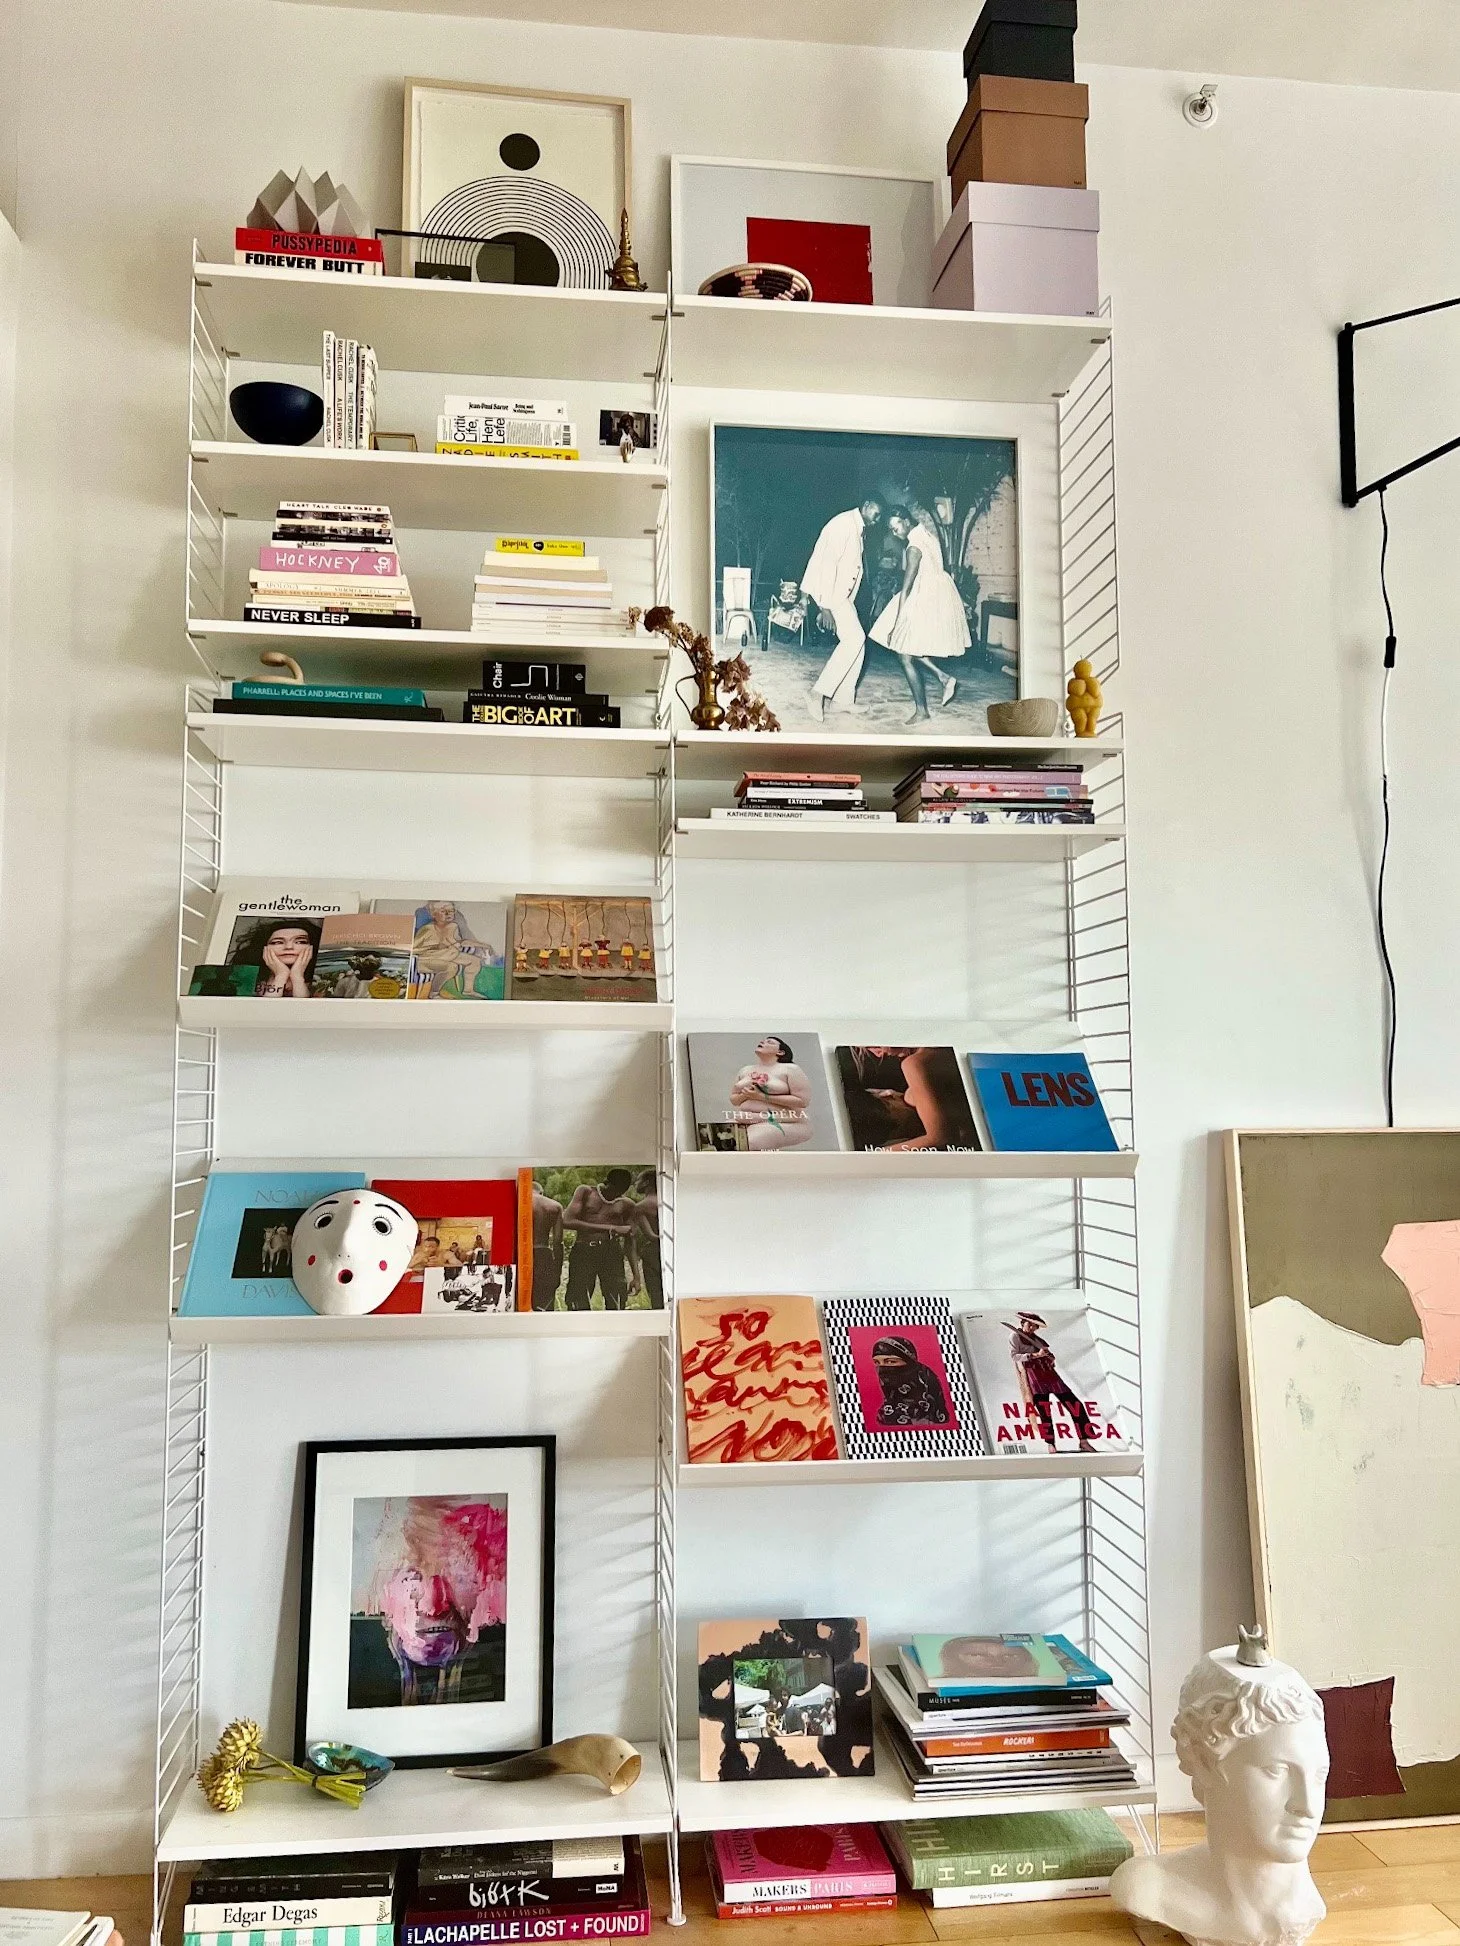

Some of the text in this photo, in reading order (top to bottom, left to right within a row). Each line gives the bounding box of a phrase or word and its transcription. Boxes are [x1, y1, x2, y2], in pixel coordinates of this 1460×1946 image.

[272, 234, 357, 254] PUSSYPEDIA
[245, 253, 364, 274] FOREVER BUTT
[466, 419, 478, 443] Life,
[276, 552, 360, 573] HOCKNEY
[251, 609, 350, 625] NEVER SLEEP
[492, 662, 502, 689] Chair
[281, 688, 306, 696] PLACES
[308, 690, 324, 698] AND
[324, 690, 349, 698] SPACES
[364, 692, 382, 700] BEEN
[548, 694, 572, 702] Woman
[472, 704, 480, 722] THE
[484, 705, 517, 724] BIG
[524, 706, 535, 724] OF
[534, 707, 576, 726] ART
[788, 798, 823, 806] EXTREMISM
[239, 900, 341, 912] gentlewoman
[281, 894, 302, 904] the
[1002, 1070, 1098, 1108] LENS
[722, 1108, 808, 1120] THE OPÉRA
[864, 1144, 975, 1152] How Soon Now
[1002, 1402, 1101, 1418] NATIVE
[997, 1422, 1122, 1442] AMERICA
[1003, 1736, 1034, 1746] ROCKERS
[938, 1860, 1060, 1881] HIRST
[752, 1884, 807, 1897] MAKERS
[814, 1880, 852, 1894] PARIS
[223, 1906, 318, 1928] Edgar Degas
[477, 1907, 552, 1919] DEANA LAWSON
[732, 1905, 753, 1915] Judith
[754, 1904, 772, 1913] Scott
[414, 1915, 638, 1944] LACHAPELLE LOST + FOUND
